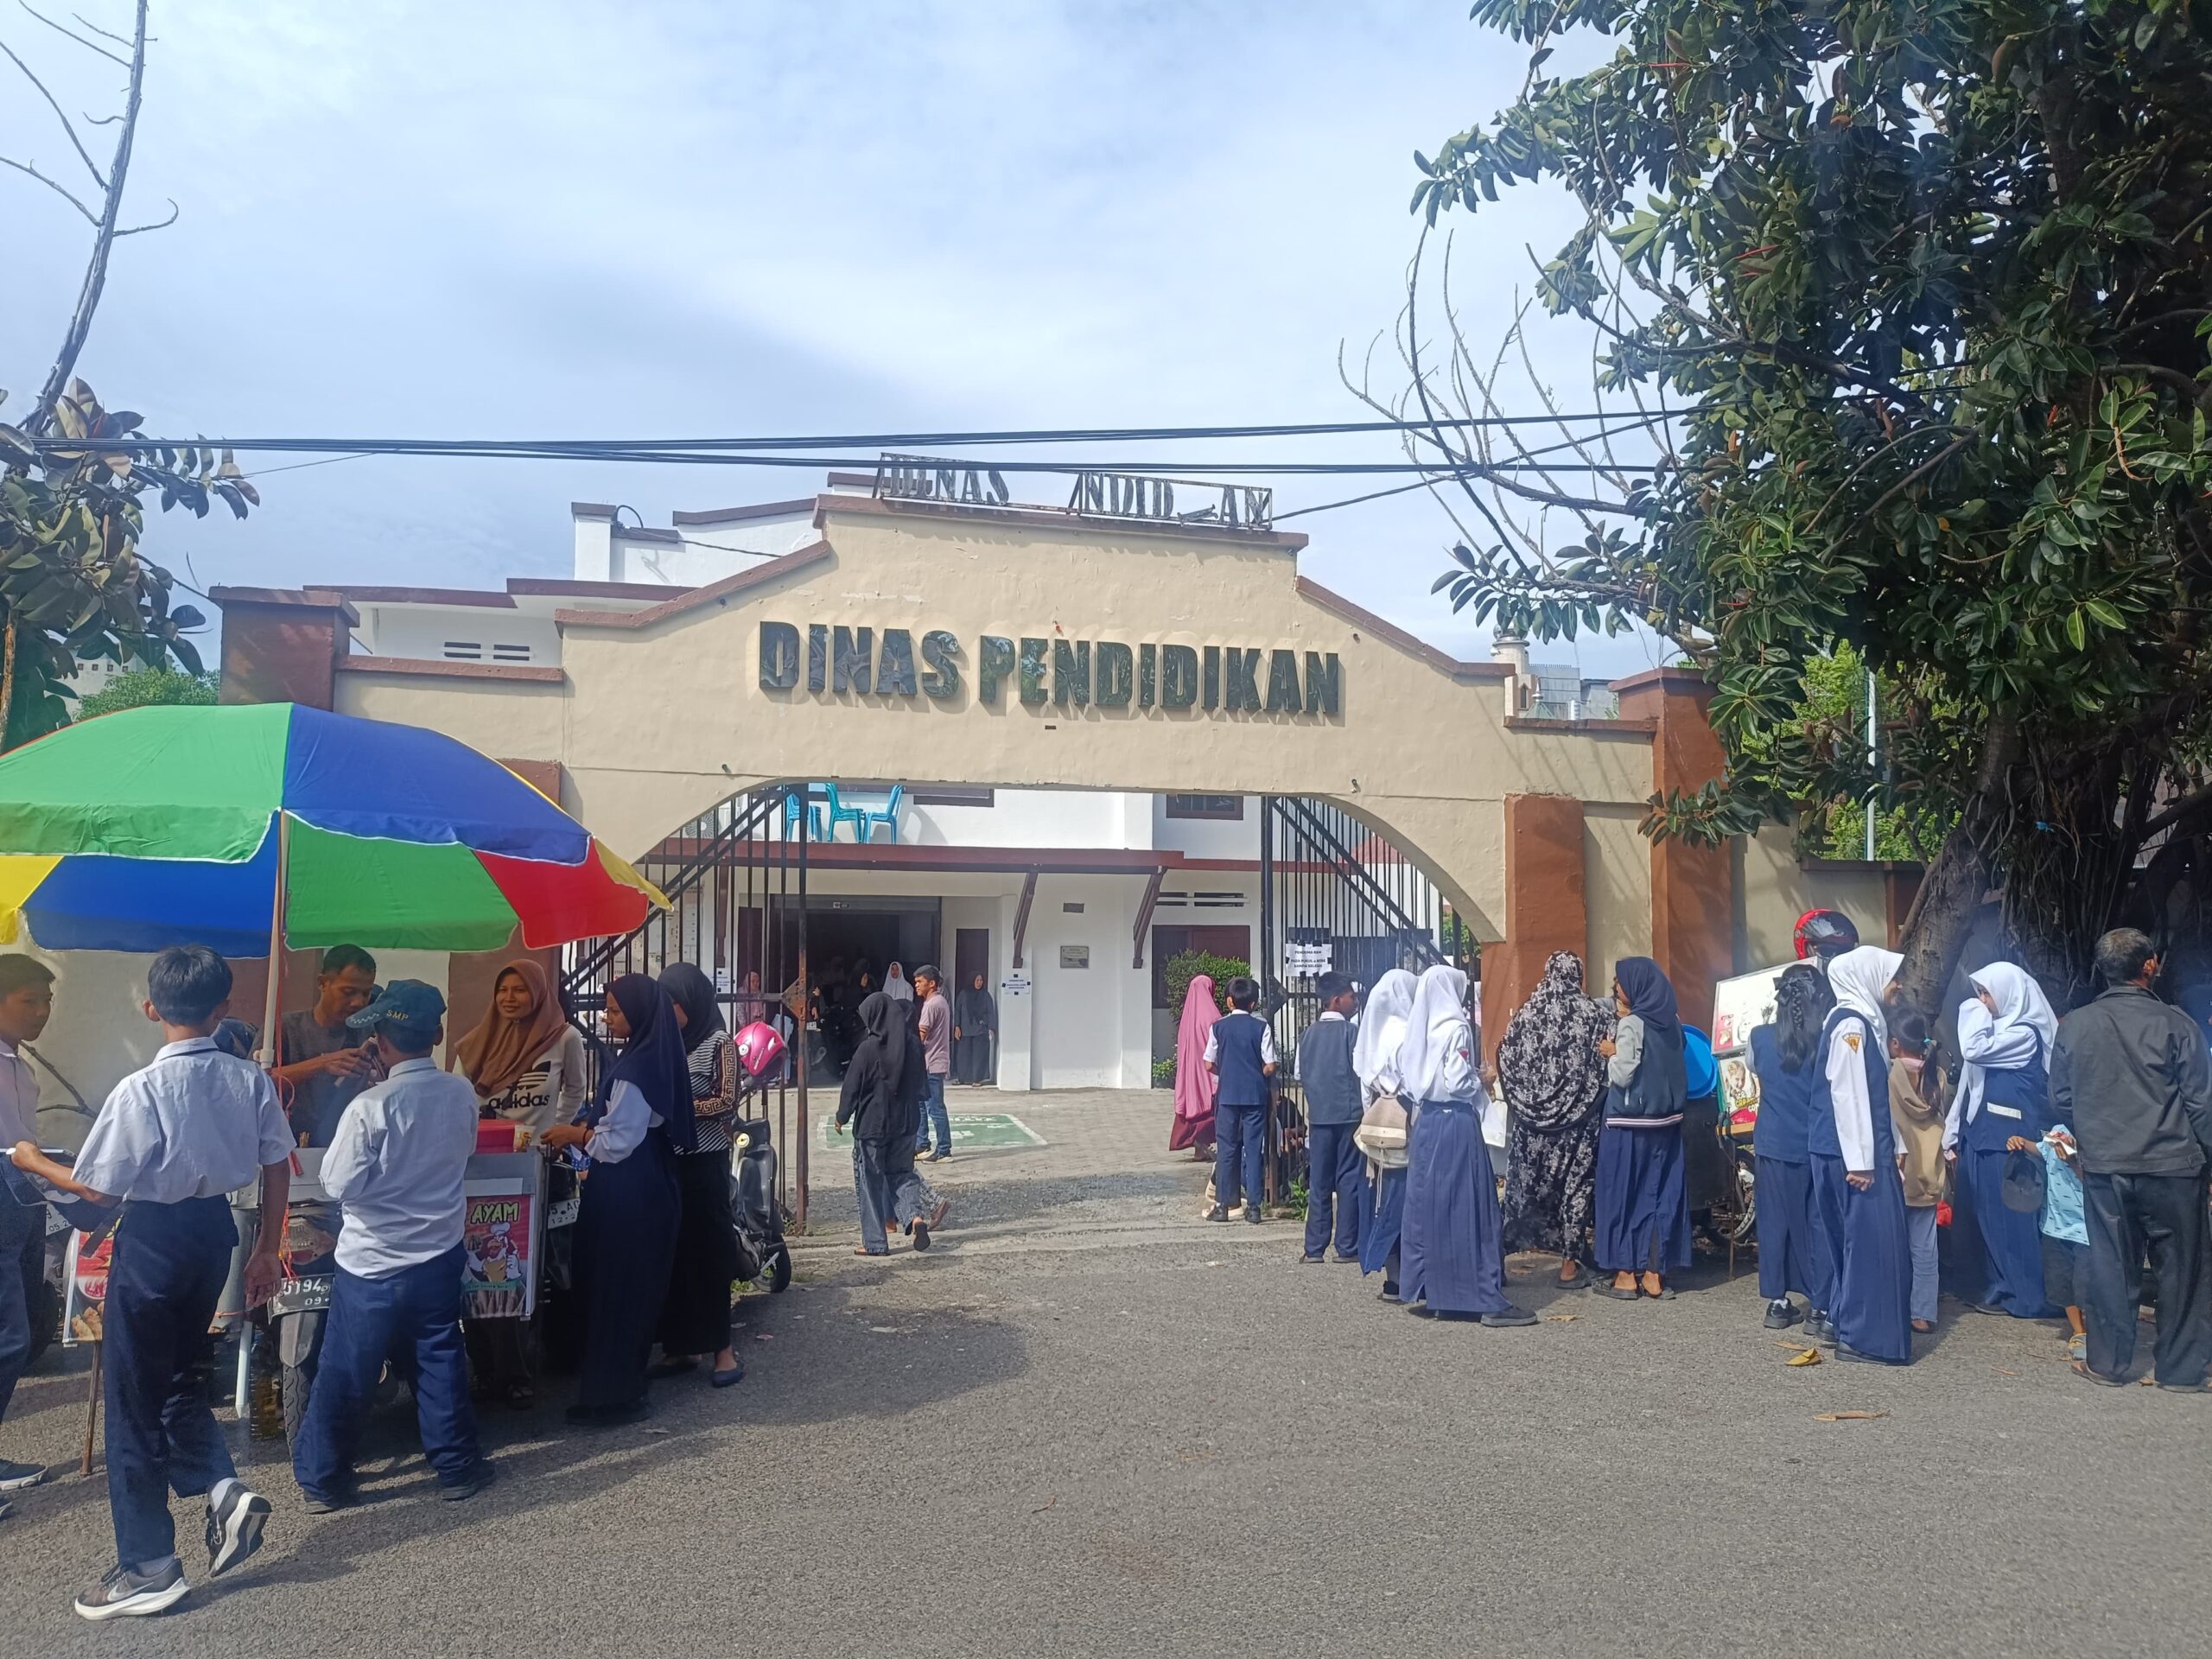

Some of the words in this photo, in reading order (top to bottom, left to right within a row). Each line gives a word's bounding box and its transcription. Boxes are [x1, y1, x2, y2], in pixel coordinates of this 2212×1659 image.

[760, 621, 960, 698] DINAS
[979, 635, 1339, 714] PENDIDIKAN
[386, 1009, 409, 1021] SMP
[470, 1202, 519, 1224] AYAM
